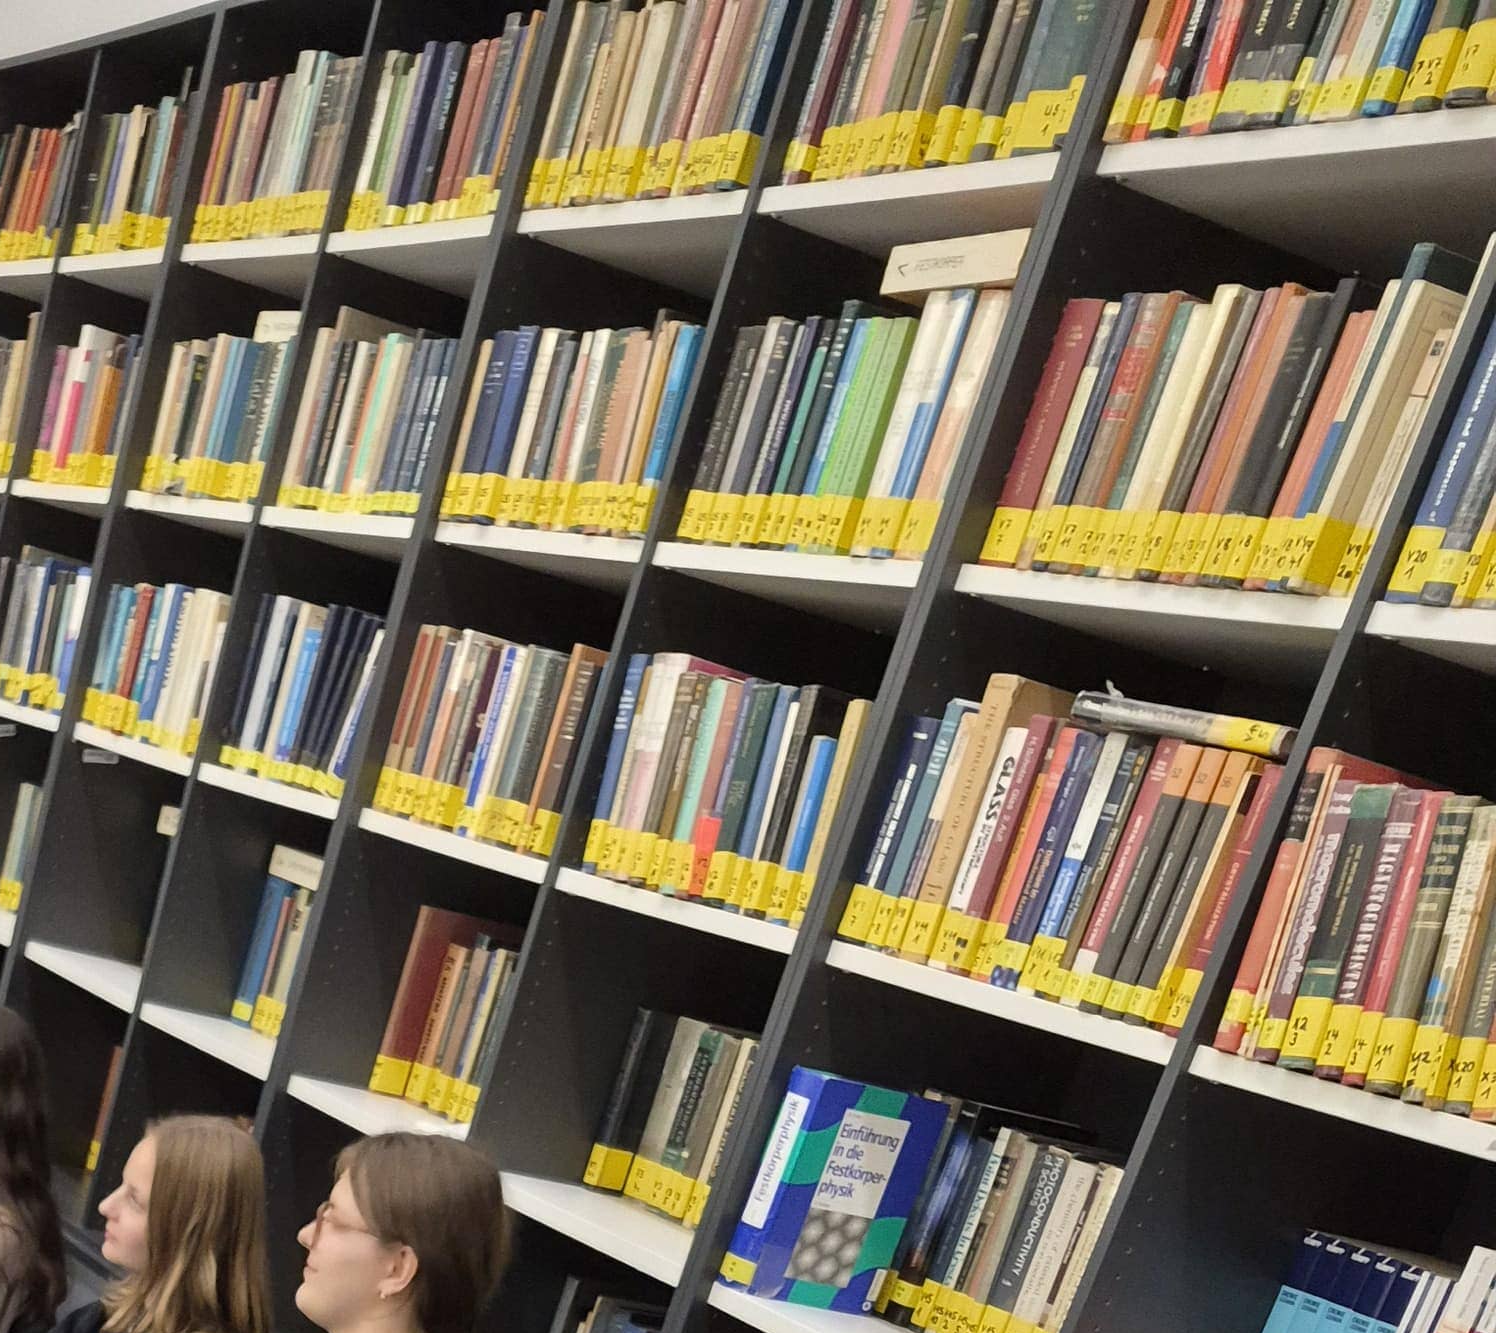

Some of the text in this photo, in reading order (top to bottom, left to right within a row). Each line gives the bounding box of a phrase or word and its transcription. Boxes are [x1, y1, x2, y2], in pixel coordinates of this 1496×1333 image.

[1460, 415, 1475, 437] and
[1432, 439, 1466, 507] Evaporation
[983, 702, 998, 730] THE
[983, 753, 1016, 824] GLASS
[1338, 839, 1401, 1004] MAGNETOCHEMISTRY
[1289, 1032, 1298, 1046] 3
[1324, 1043, 1333, 1055] 2
[840, 1124, 900, 1152] Einführung
[833, 1144, 864, 1161] in die
[826, 1162, 887, 1185] Festkörper-
[1028, 1167, 1050, 1207] SOLIDS
[818, 1182, 855, 1199] physik
[1010, 1156, 1065, 1276] PHOTOCONDUCTIVITY
